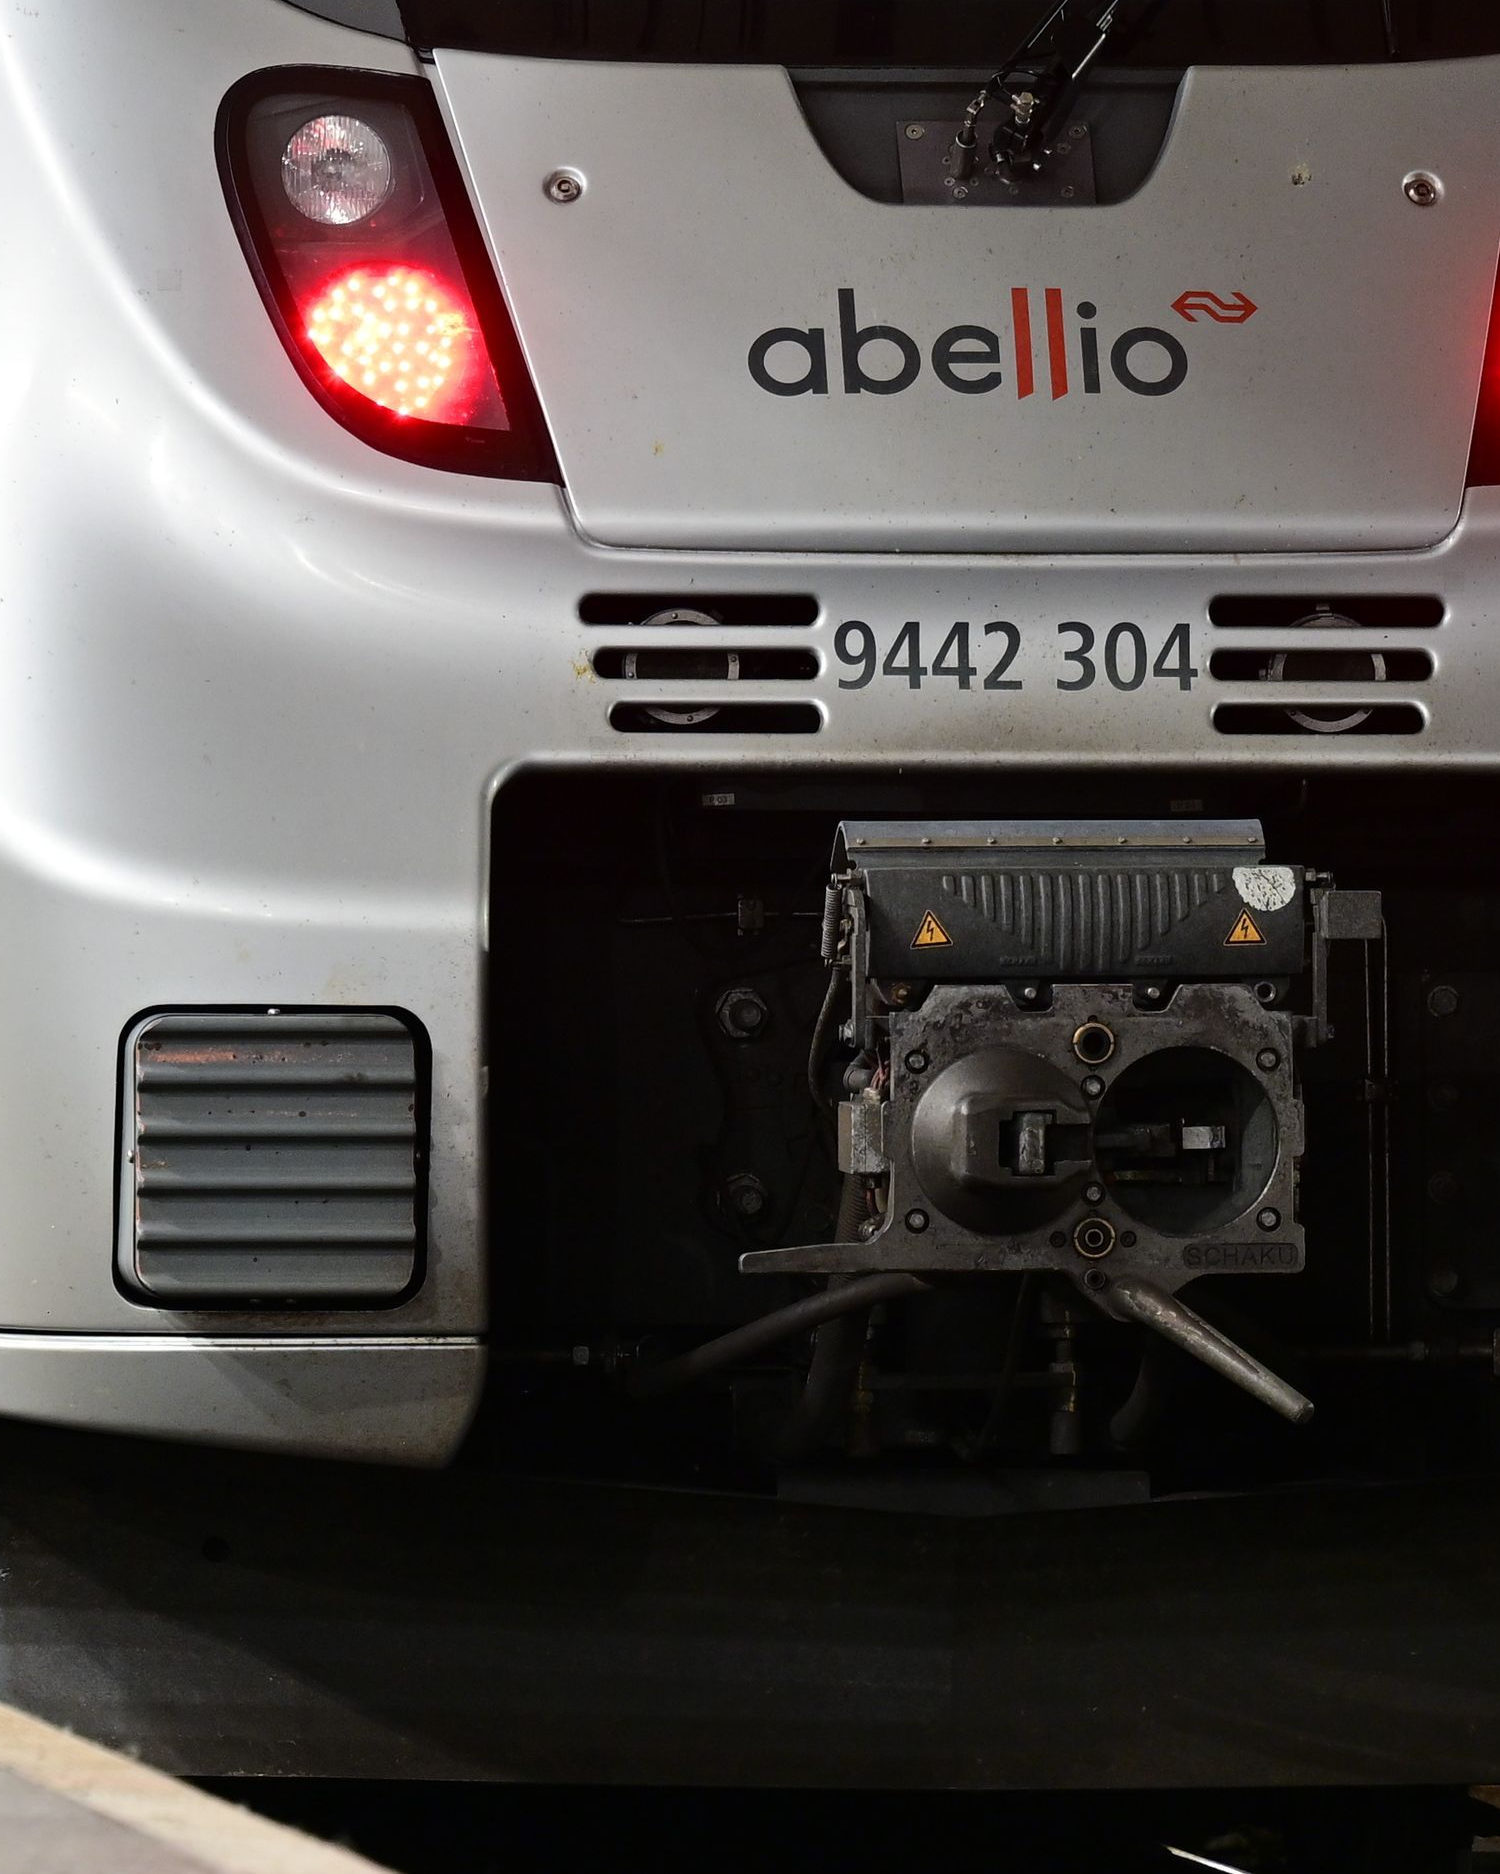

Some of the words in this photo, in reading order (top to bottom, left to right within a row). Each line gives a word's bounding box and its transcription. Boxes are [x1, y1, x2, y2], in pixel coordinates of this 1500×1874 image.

[748, 288, 1188, 401] abellio
[835, 621, 1022, 690] 9442
[1057, 622, 1199, 691] 304
[1187, 1244, 1294, 1266] SCHAKU
